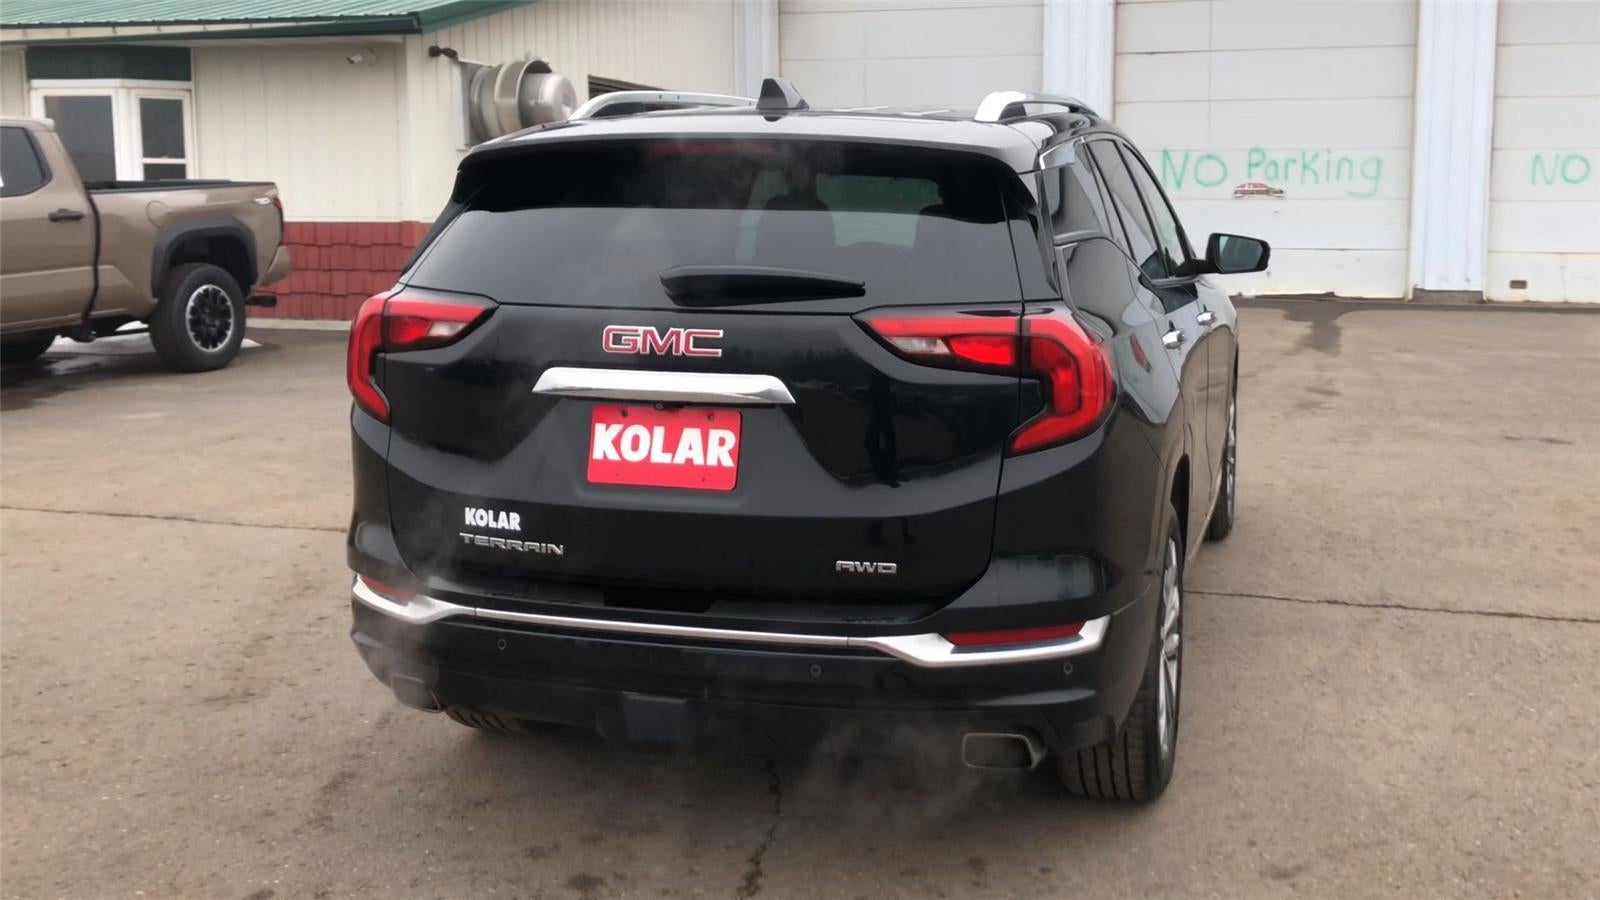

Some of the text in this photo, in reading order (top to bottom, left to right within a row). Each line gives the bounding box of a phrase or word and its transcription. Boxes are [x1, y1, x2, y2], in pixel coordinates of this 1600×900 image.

[1161, 148, 1228, 190] NO
[1529, 152, 1591, 186] NO
[602, 325, 723, 357] GMC
[592, 422, 735, 468] KOLAR
[464, 507, 521, 531] KOLAR
[460, 533, 564, 556] TERRAIN
[835, 560, 897, 574] AWD
